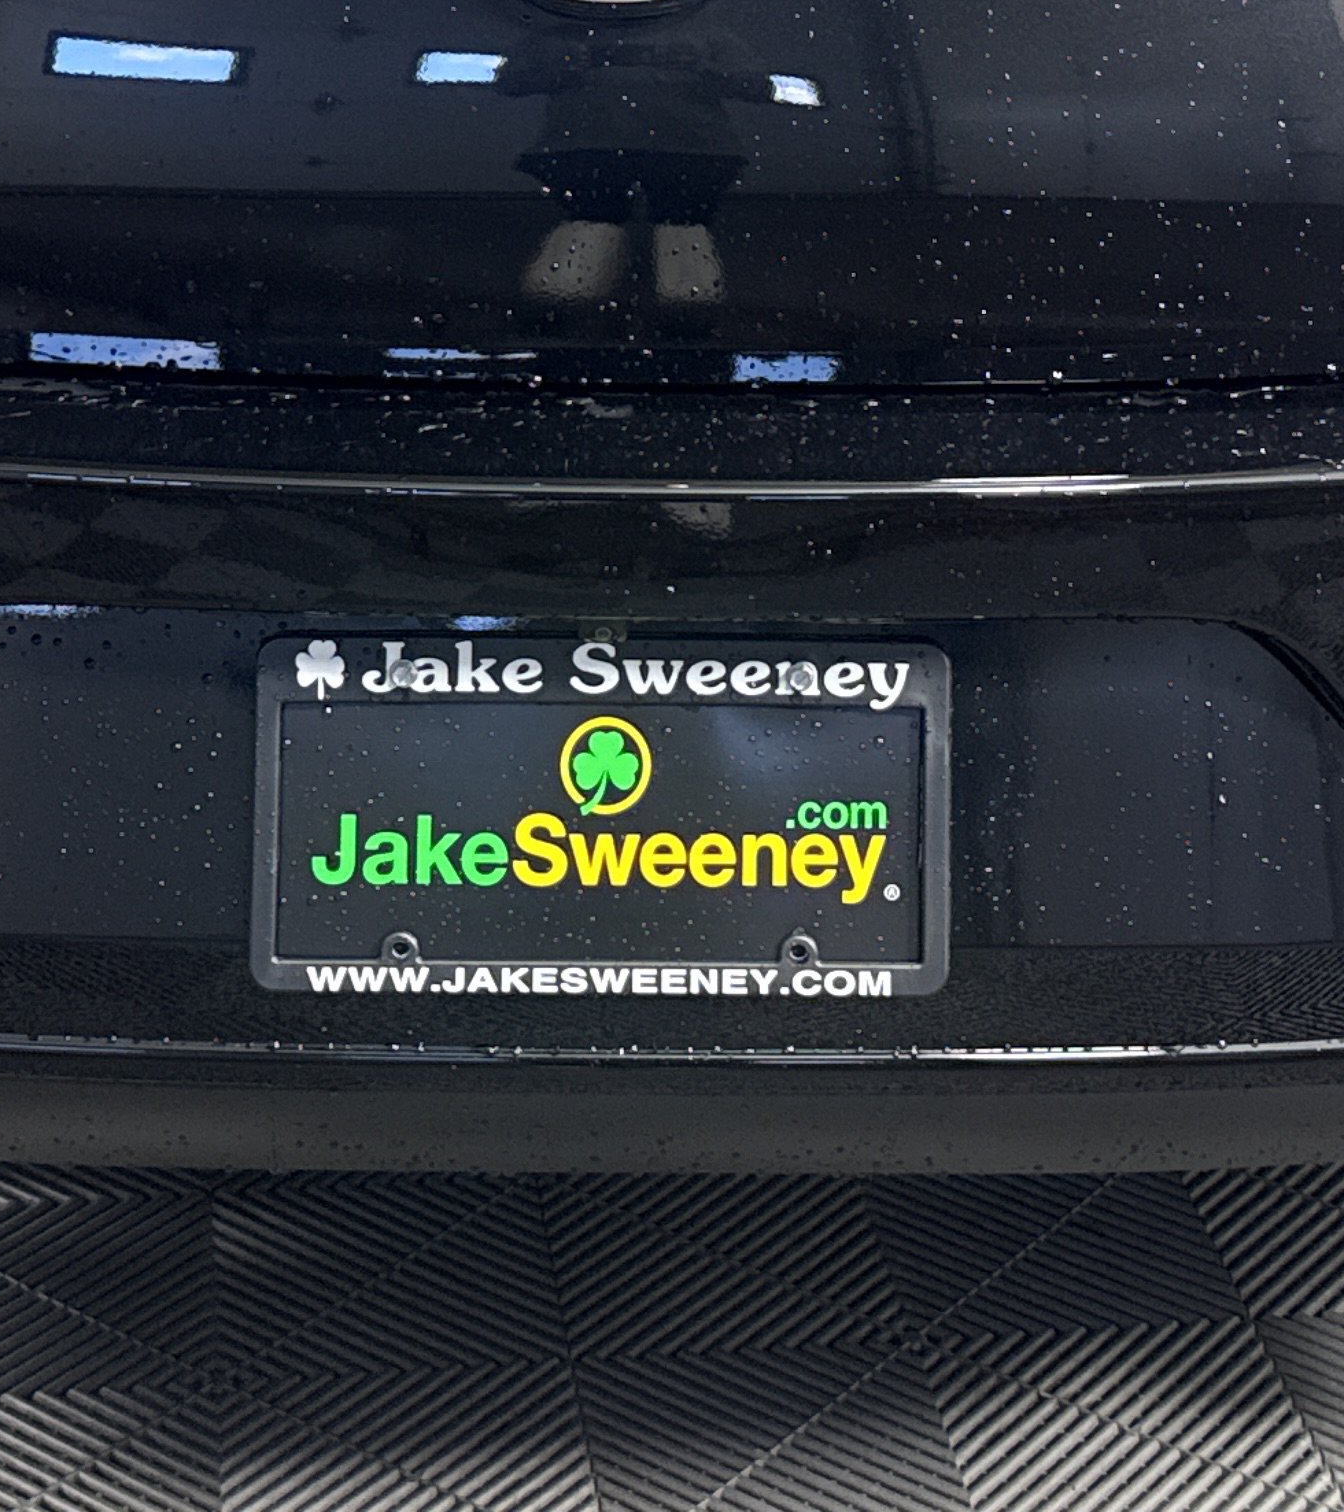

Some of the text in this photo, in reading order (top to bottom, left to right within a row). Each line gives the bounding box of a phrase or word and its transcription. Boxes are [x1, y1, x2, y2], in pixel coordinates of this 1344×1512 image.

[361, 640, 910, 710] Jake Sweeney
[306, 966, 893, 998] WWW.JAKESWEENEY.COM
